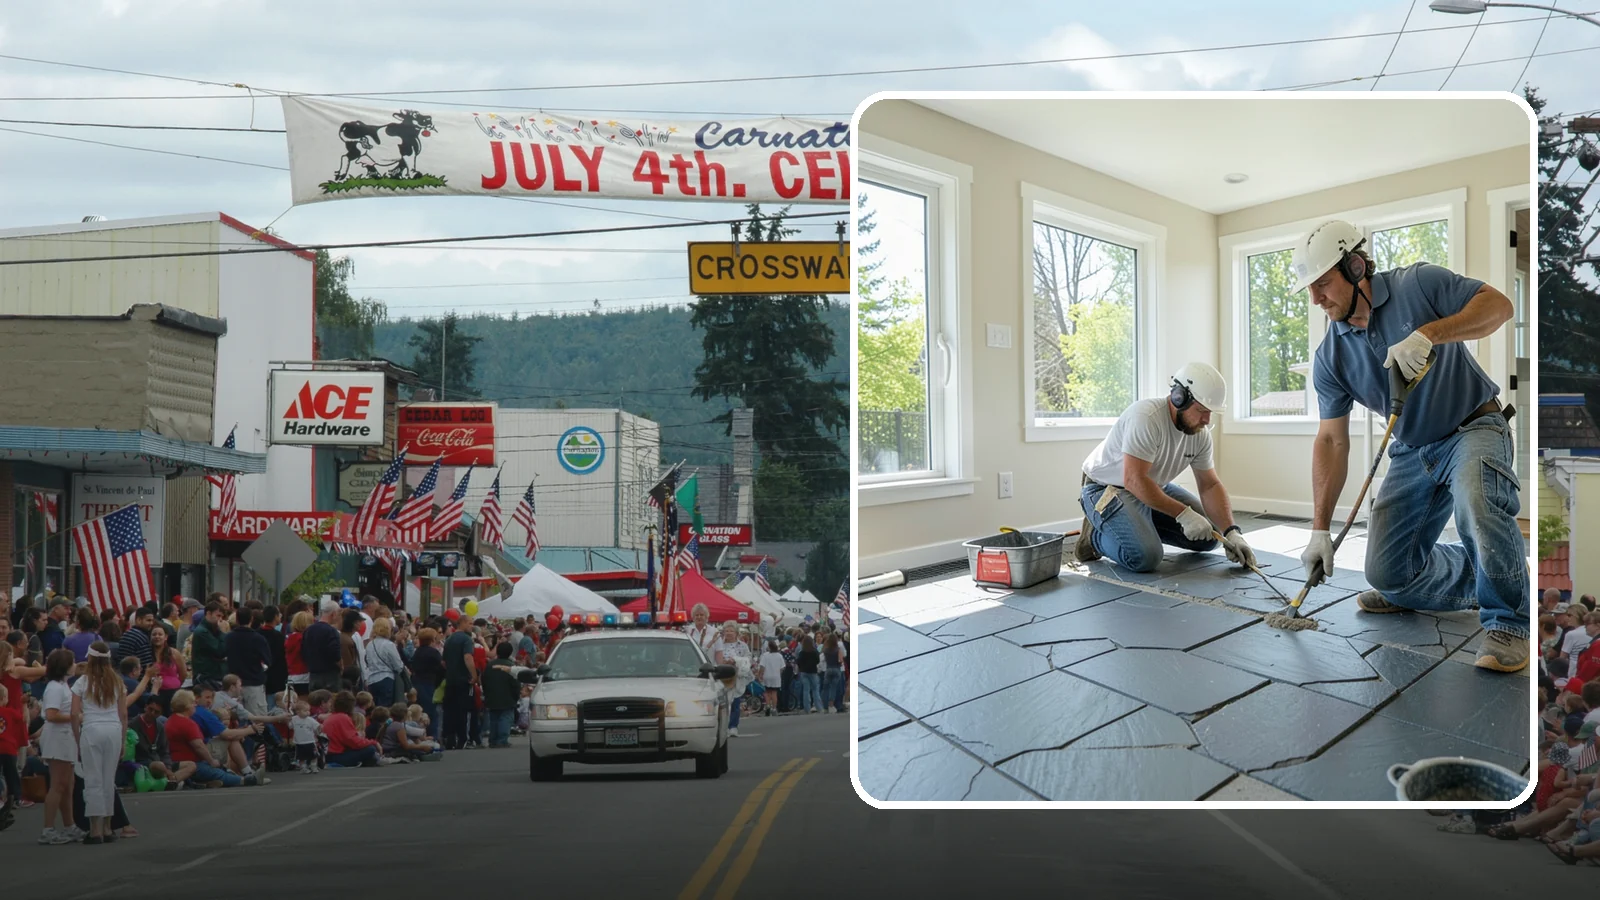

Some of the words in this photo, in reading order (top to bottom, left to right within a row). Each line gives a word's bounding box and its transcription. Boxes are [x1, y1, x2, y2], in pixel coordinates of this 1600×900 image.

[481, 141, 605, 192] JULY
[632, 150, 746, 197] 4th.
[696, 253, 850, 280] CROSSWA
[283, 380, 373, 420] ACE
[283, 421, 371, 436] Hardware
[416, 428, 477, 447] Coca-Cola
[353, 466, 385, 479] Simpl
[96, 485, 124, 495] Vincent
[126, 486, 135, 494] de
[138, 486, 155, 495] Paul
[688, 526, 741, 535] CRNATION
[699, 535, 730, 543] GLASS
